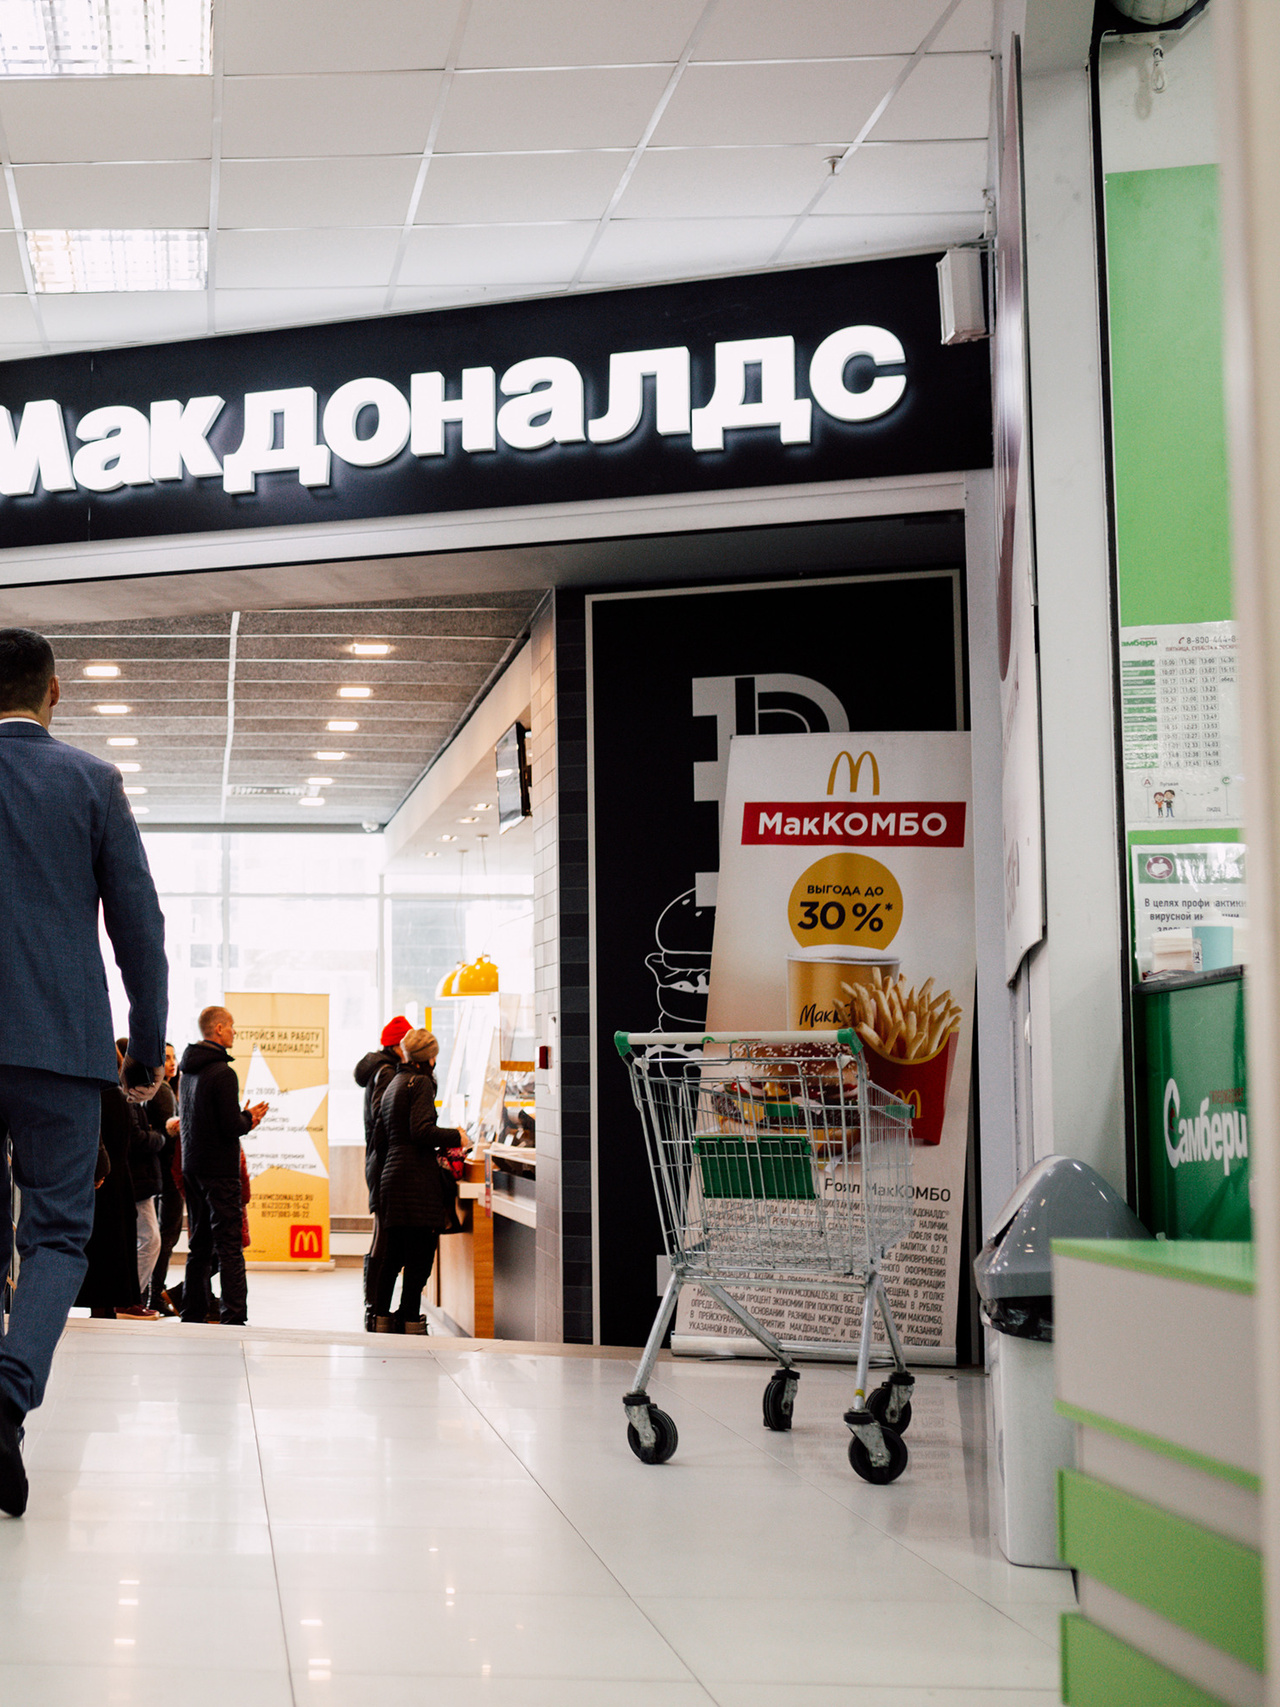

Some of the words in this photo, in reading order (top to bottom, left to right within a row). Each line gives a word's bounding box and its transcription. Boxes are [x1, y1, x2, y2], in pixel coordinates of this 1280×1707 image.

[1121, 638, 1158, 649] амбери
[757, 811, 948, 838] МакКОМБО
[807, 885, 861, 897] ВЫГОДА
[864, 886, 884, 897] ДО
[1144, 898, 1151, 908] В
[1153, 899, 1179, 909] целях
[1182, 898, 1247, 911] профиактики
[1150, 911, 1192, 923] вирусной
[278, 1031, 287, 1040] НА
[291, 1031, 320, 1041] РАБОТУ
[1163, 1078, 1248, 1177] Самбери
[824, 1177, 861, 1195] Роял
[900, 1241, 927, 1253] НАПИТОК
[904, 1265, 946, 1278] ОФОРМЛЕНИЯ
[903, 1277, 946, 1290] ИНФОРМАЦИЯ
[746, 1293, 771, 1305] ПРОЦЕНТ
[772, 1296, 804, 1309] ЭКОНОМИИ
[805, 1300, 816, 1310] ПРИ
[817, 1302, 843, 1313] ПОКУПКЕ
[922, 1291, 945, 1302] УГОЛКЕ
[688, 1321, 722, 1333] УКАЗАННОЙ
[750, 1306, 785, 1318] ОСНОВАНИИ
[787, 1310, 816, 1322] РАЗНИЦЫ
[818, 1313, 841, 1326] МЕЖДУ
[906, 1323, 943, 1337] УКАЗАННОЙ
[873, 1331, 885, 1342] ТОЙ
[903, 1335, 941, 1348] ПРОДУКЦИИ
